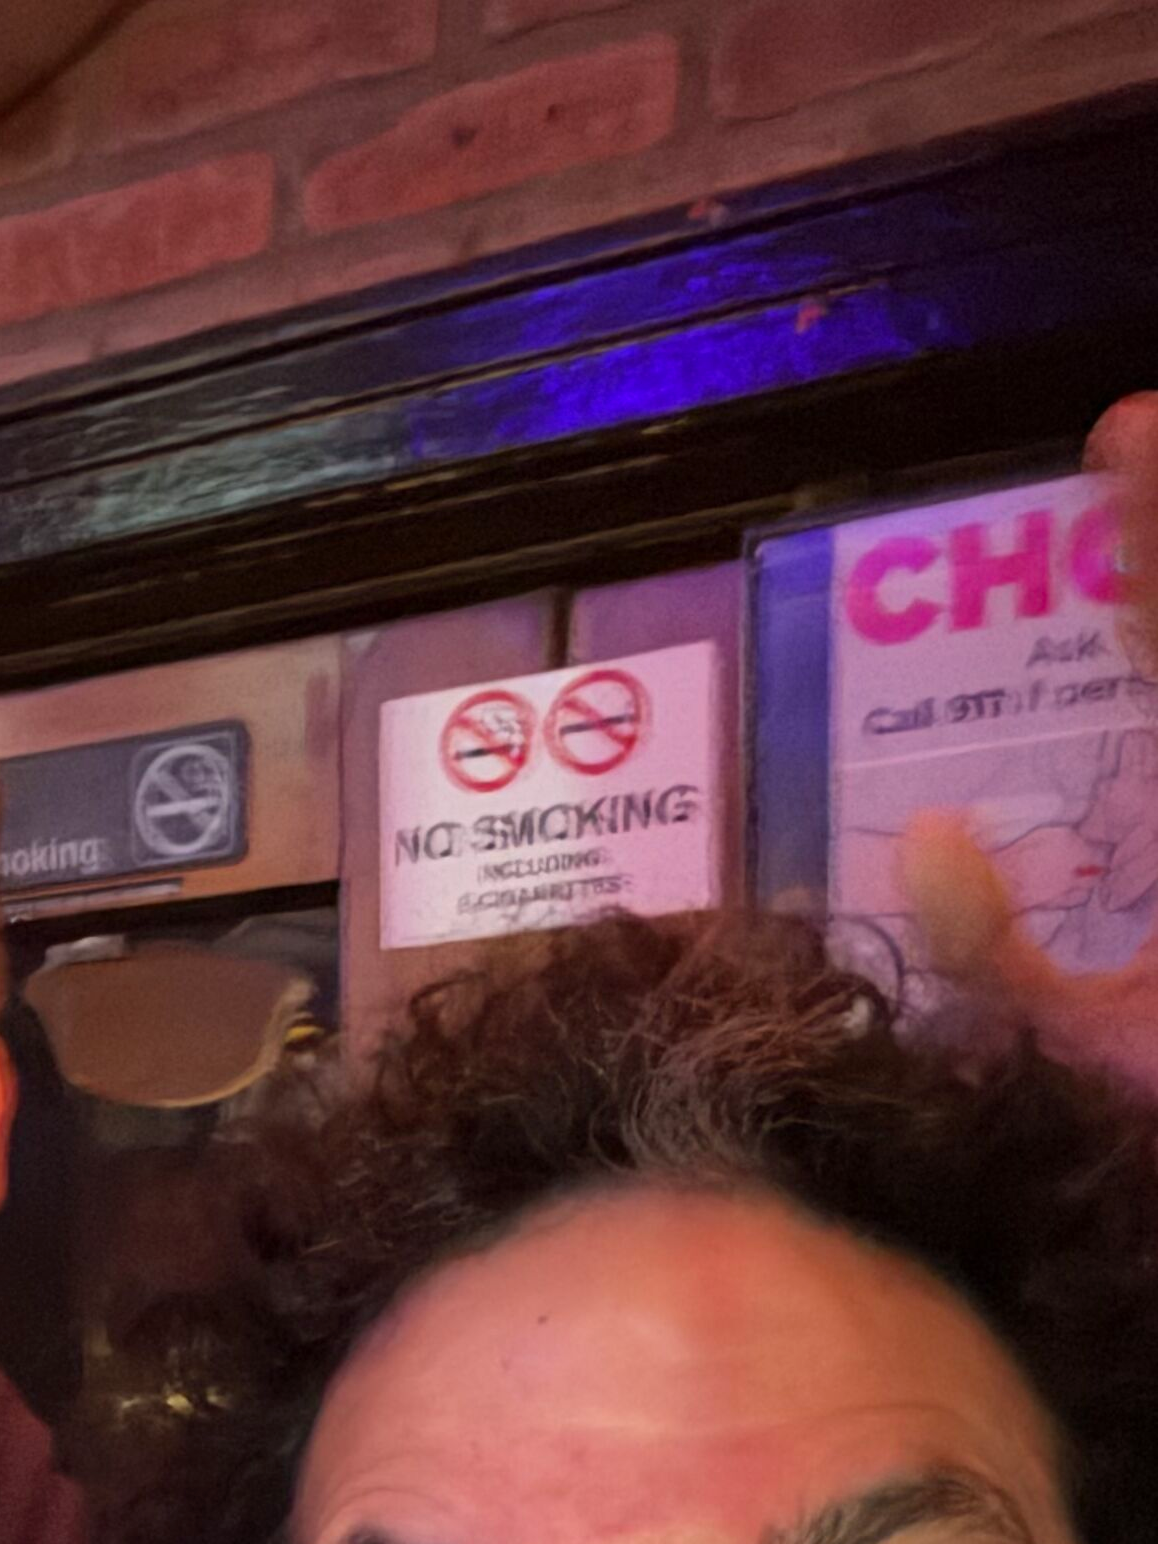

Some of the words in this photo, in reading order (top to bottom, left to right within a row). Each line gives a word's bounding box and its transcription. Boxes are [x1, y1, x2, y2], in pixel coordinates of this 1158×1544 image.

[862, 697, 935, 735] Call
[393, 821, 461, 867] NO
[470, 784, 698, 851] SMOKING
